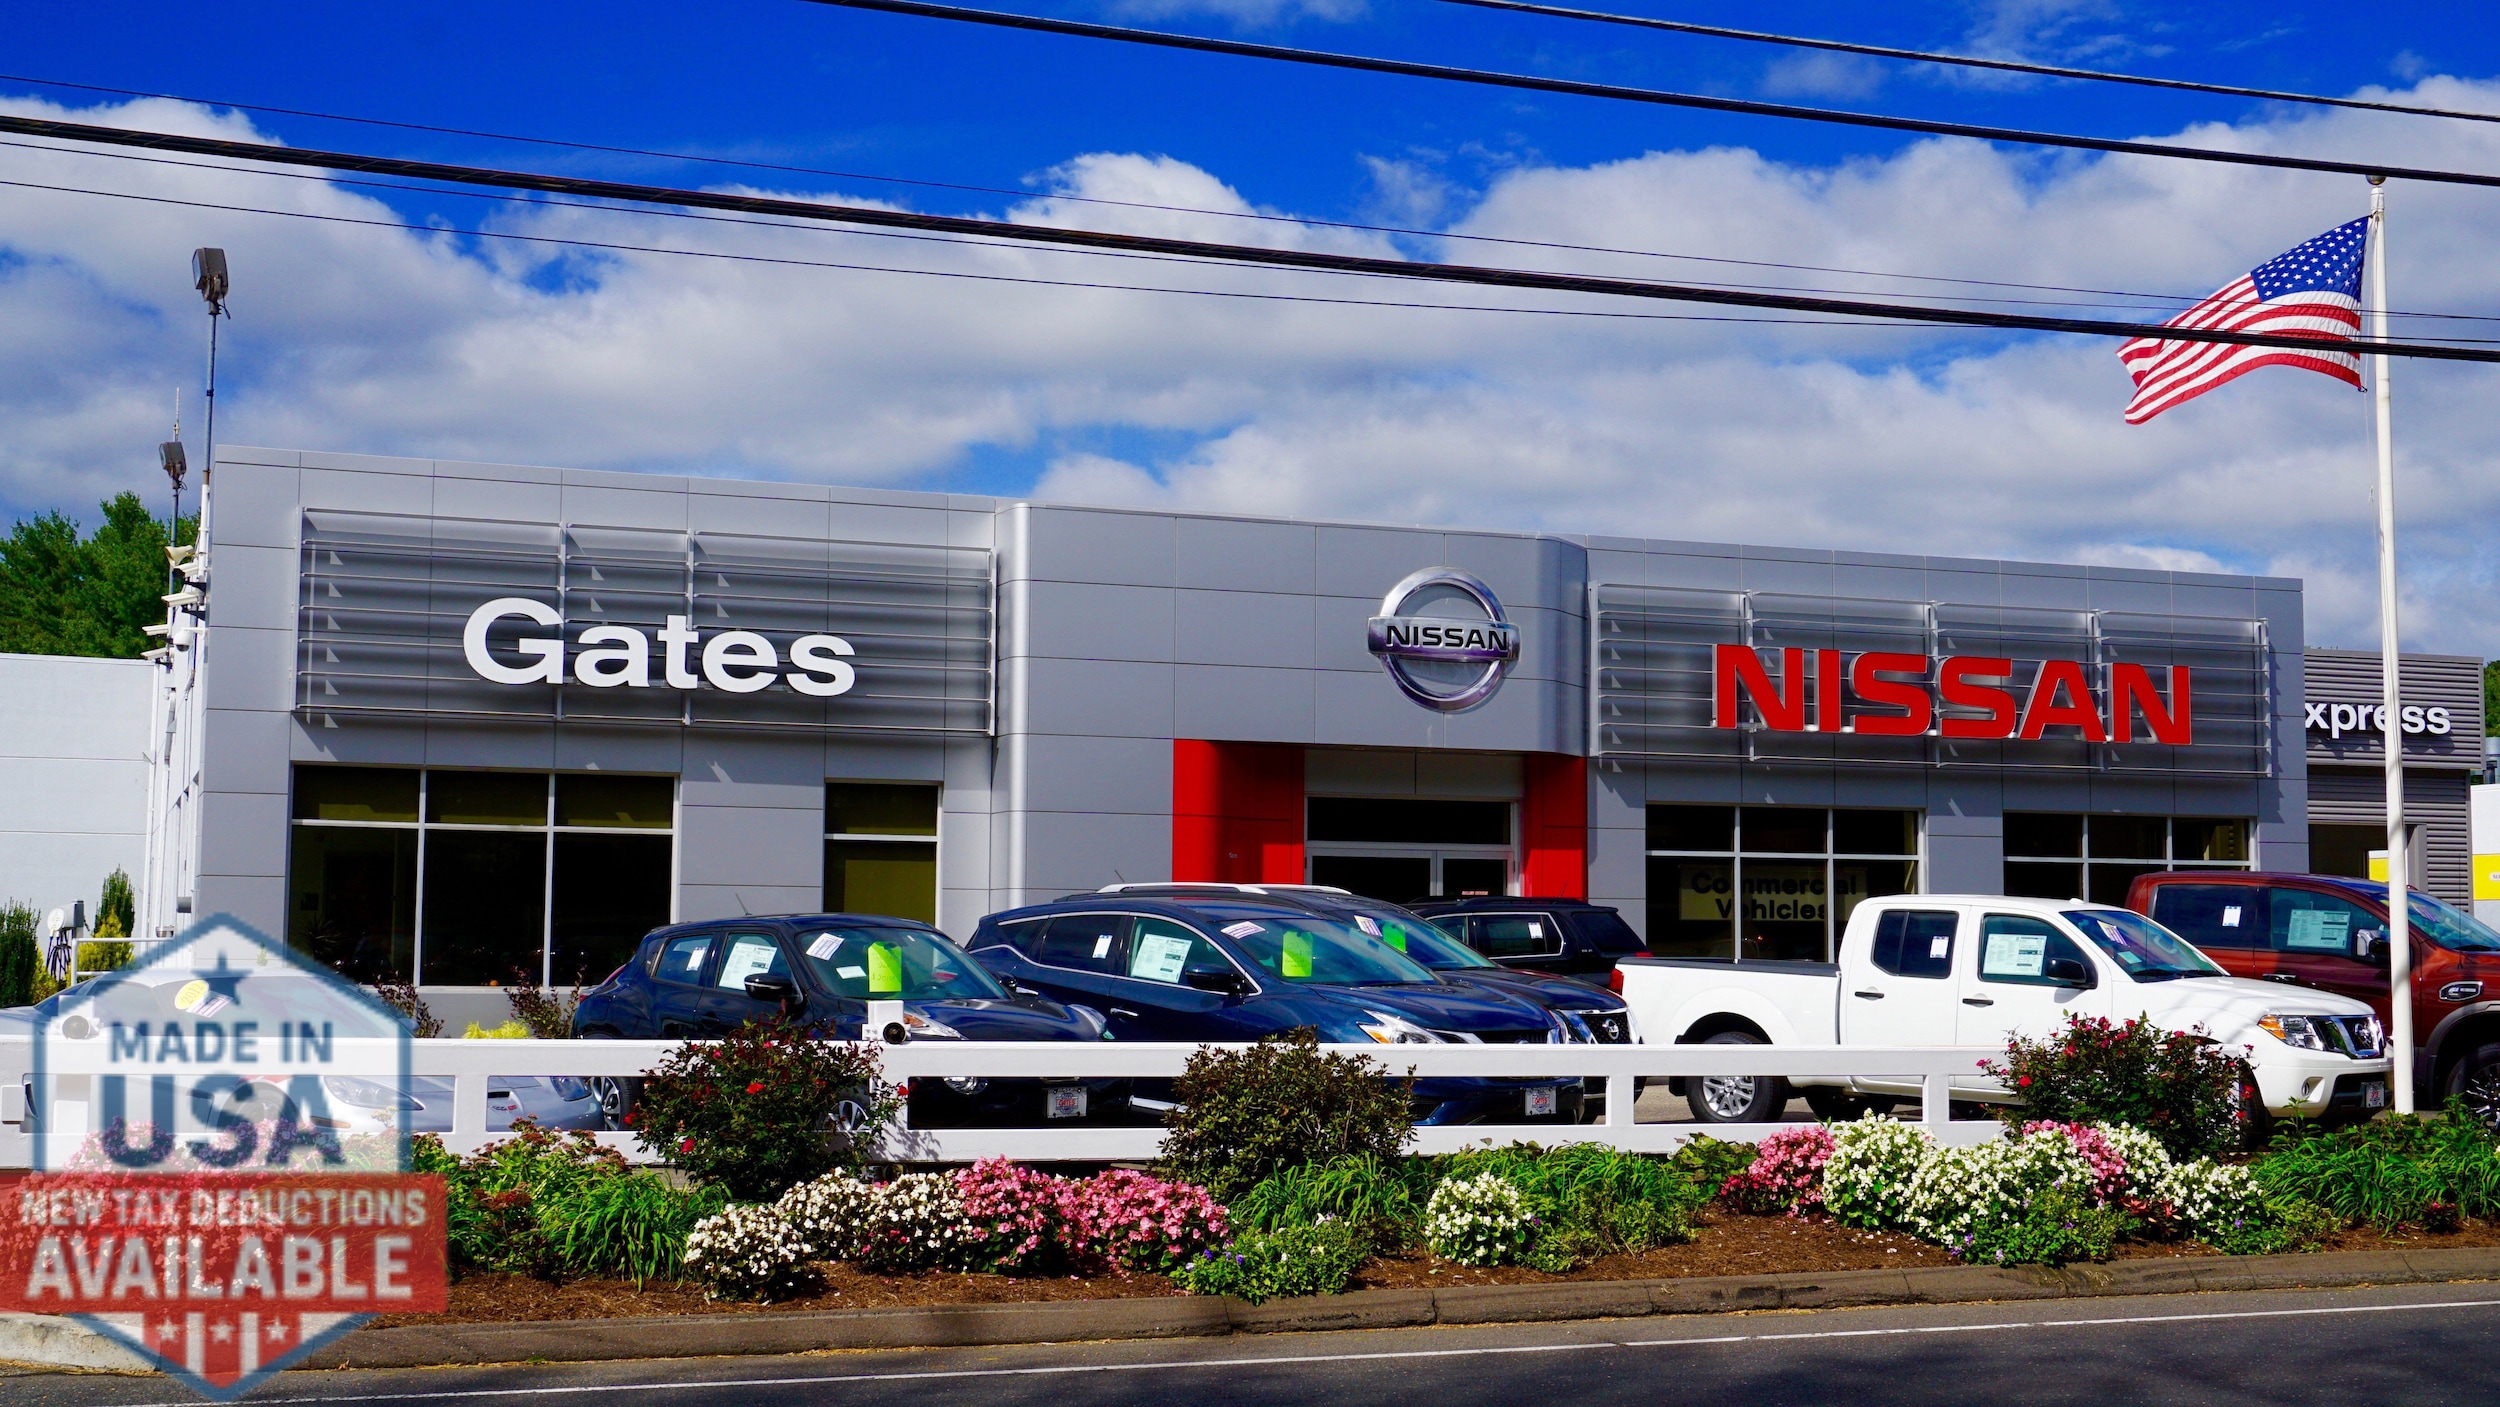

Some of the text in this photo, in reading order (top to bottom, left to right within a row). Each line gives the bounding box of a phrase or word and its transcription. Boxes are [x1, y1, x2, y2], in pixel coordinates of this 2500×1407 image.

[463, 597, 856, 698] Gates
[1386, 625, 1508, 651] NISSAN
[1713, 643, 2191, 746] NISSAN
[2305, 702, 2451, 739] xpress
[1691, 872, 1857, 895] Commercal
